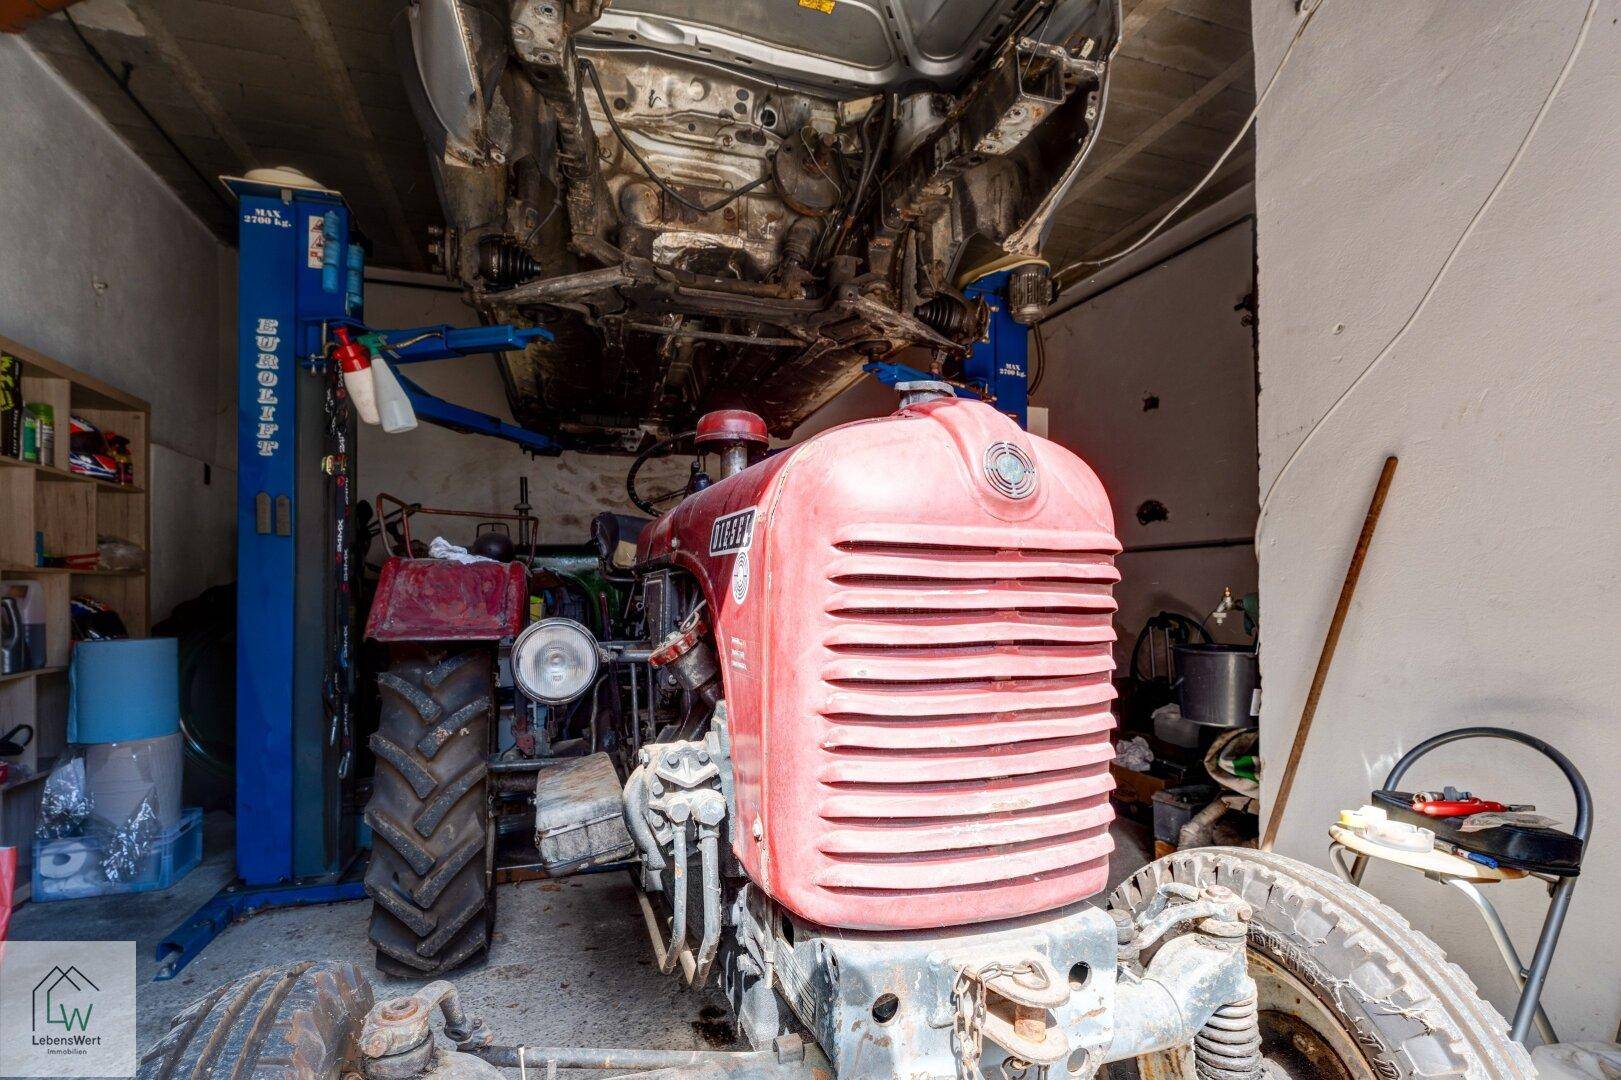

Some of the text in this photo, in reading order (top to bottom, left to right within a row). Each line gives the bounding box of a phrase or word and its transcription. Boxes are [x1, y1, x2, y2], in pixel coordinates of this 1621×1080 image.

[255, 208, 281, 218] MAX
[243, 215, 292, 229] 2700 kg.
[999, 368, 1016, 376] 2700
[1006, 363, 1021, 371] MAX
[255, 318, 281, 457] EUROLIFT
[712, 514, 752, 550] DIESEL
